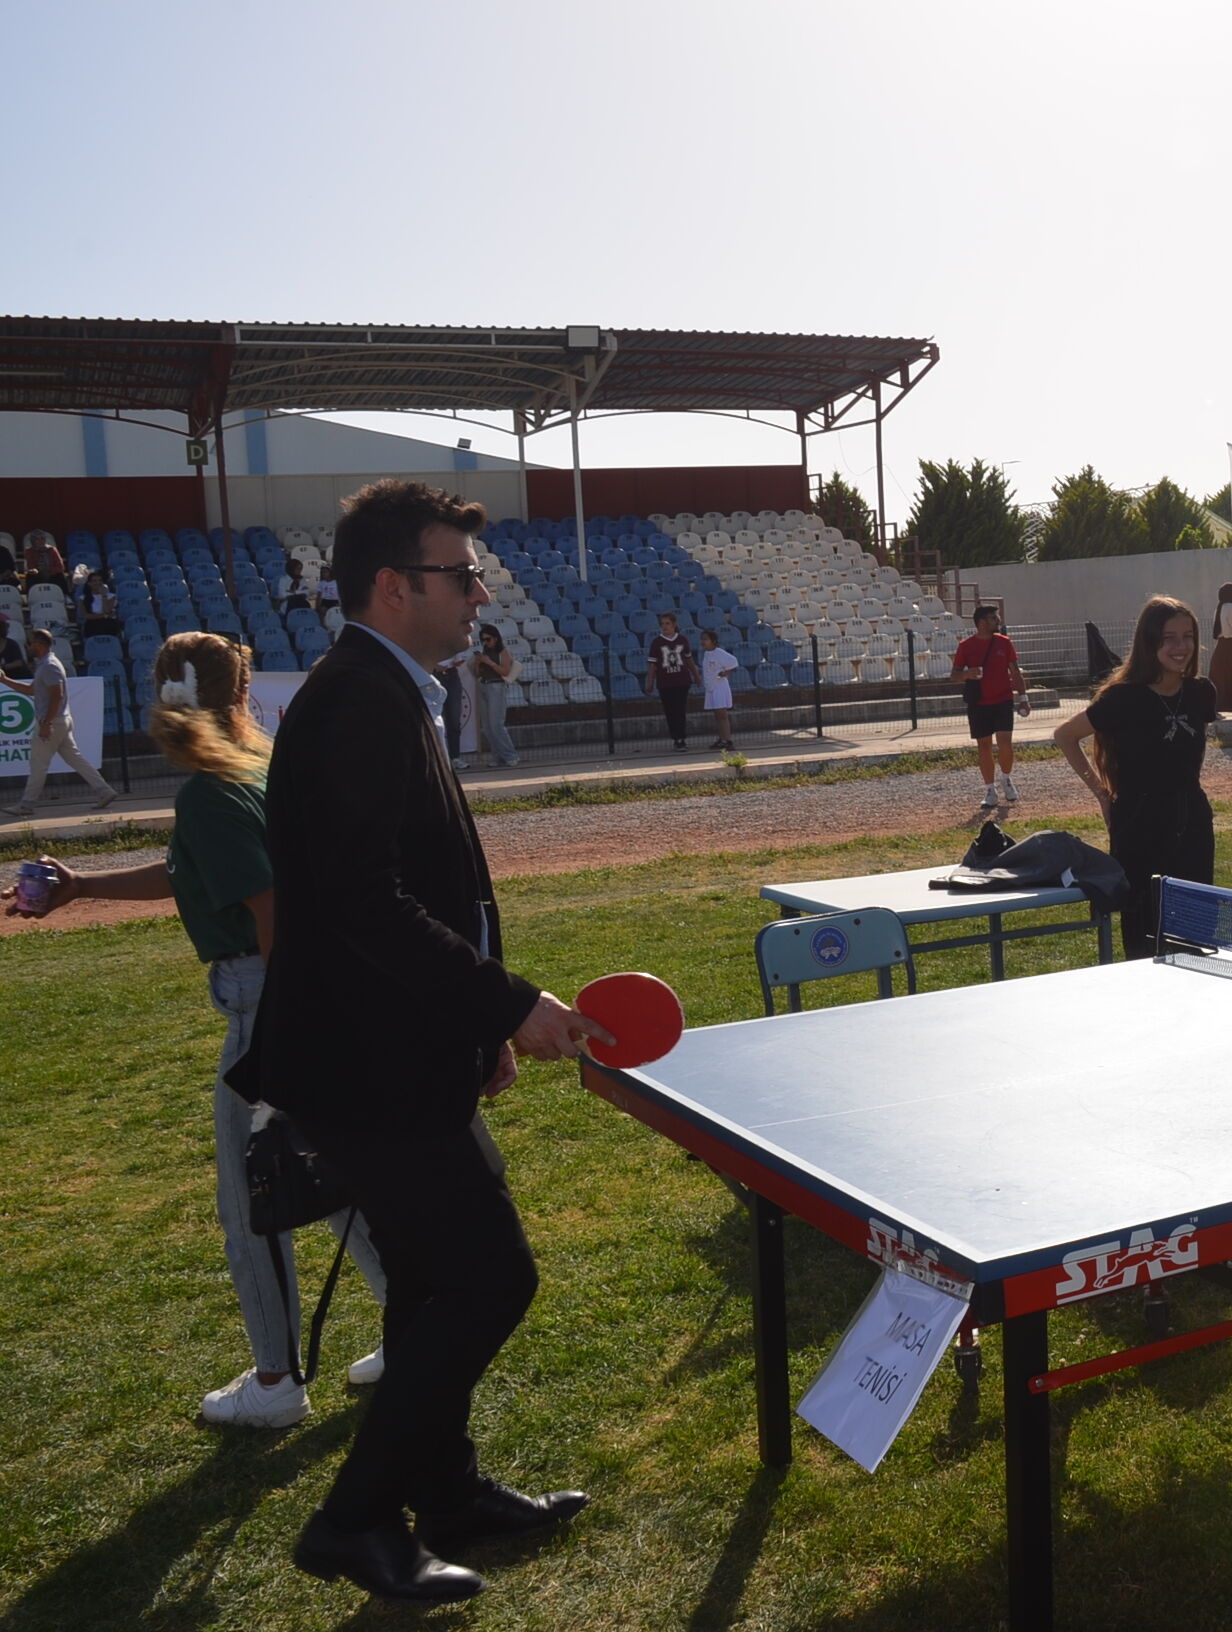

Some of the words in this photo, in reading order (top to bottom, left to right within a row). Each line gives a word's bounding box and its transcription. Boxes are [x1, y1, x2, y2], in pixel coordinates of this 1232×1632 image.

[190, 445, 204, 460] D
[1055, 1223, 1200, 1298] STAG
[884, 1311, 932, 1357] MASA
[853, 1355, 908, 1405] TENİSİ
